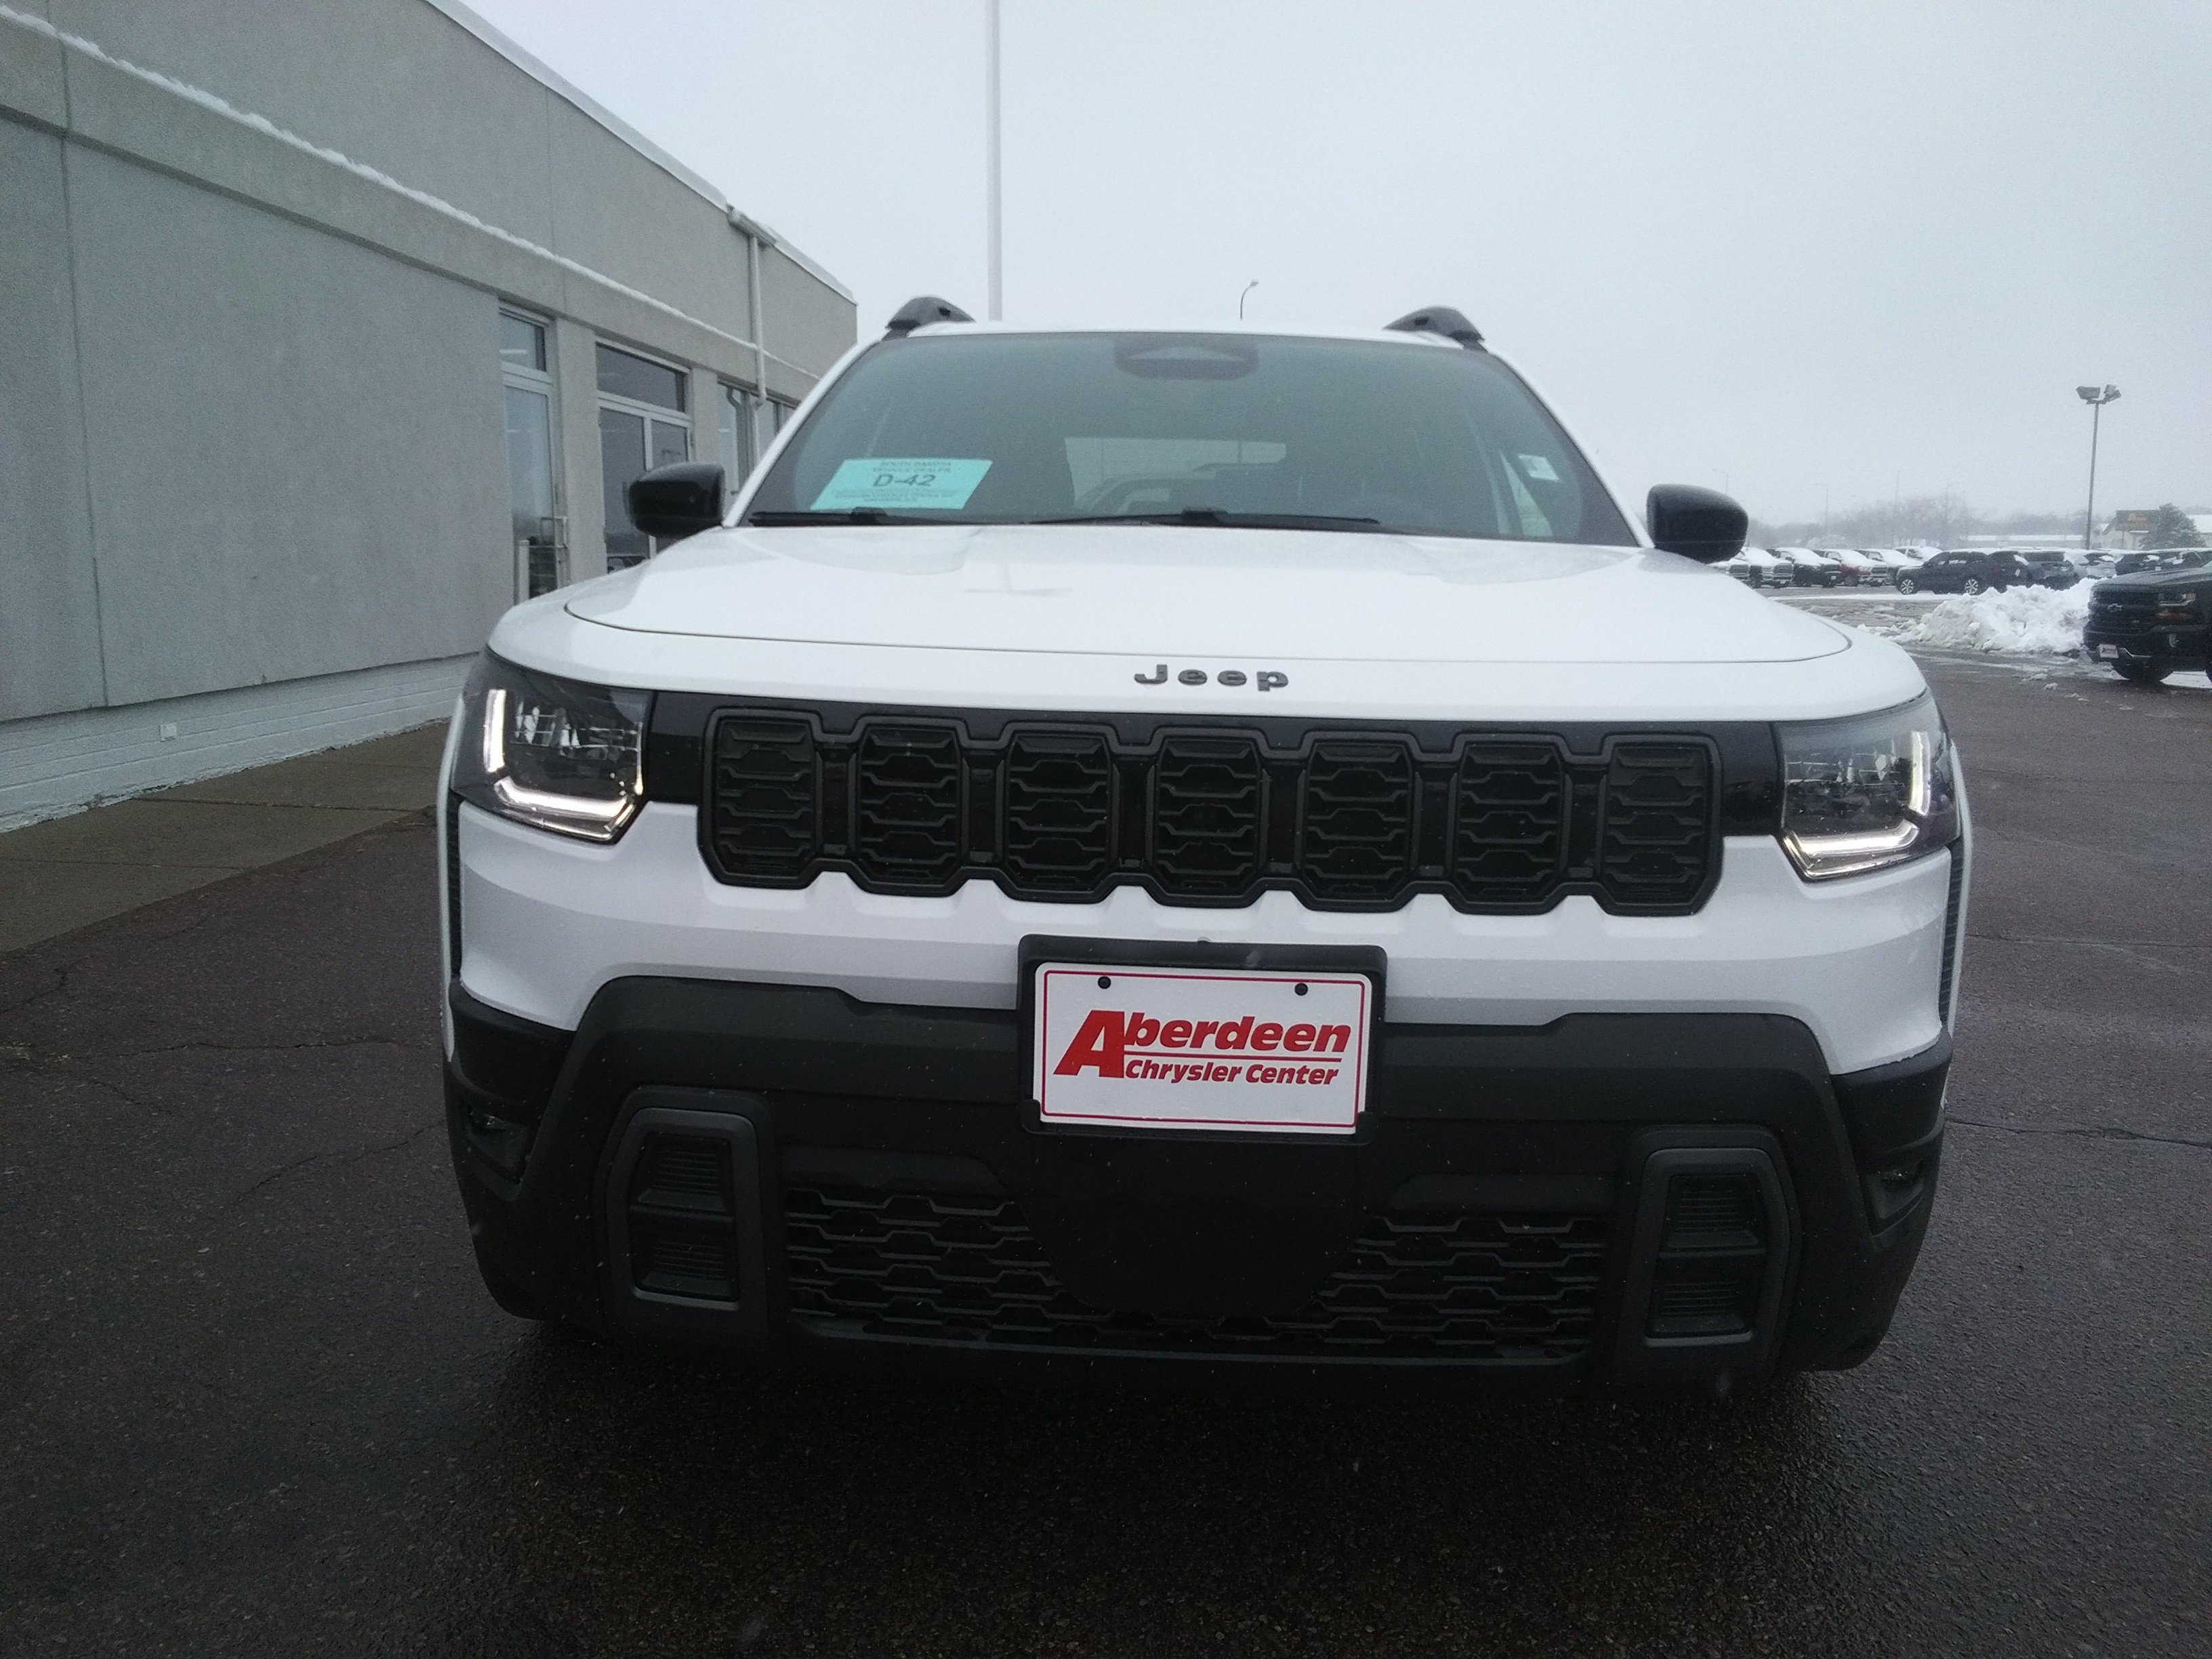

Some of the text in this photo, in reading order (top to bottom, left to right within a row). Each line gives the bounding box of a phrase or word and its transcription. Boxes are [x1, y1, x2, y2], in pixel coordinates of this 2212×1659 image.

[873, 474, 936, 487] D-42
[1134, 664, 1288, 691] Jeep
[1053, 1010, 1351, 1078] Aberdeen
[1126, 1059, 1339, 1085] Chrysler Center
